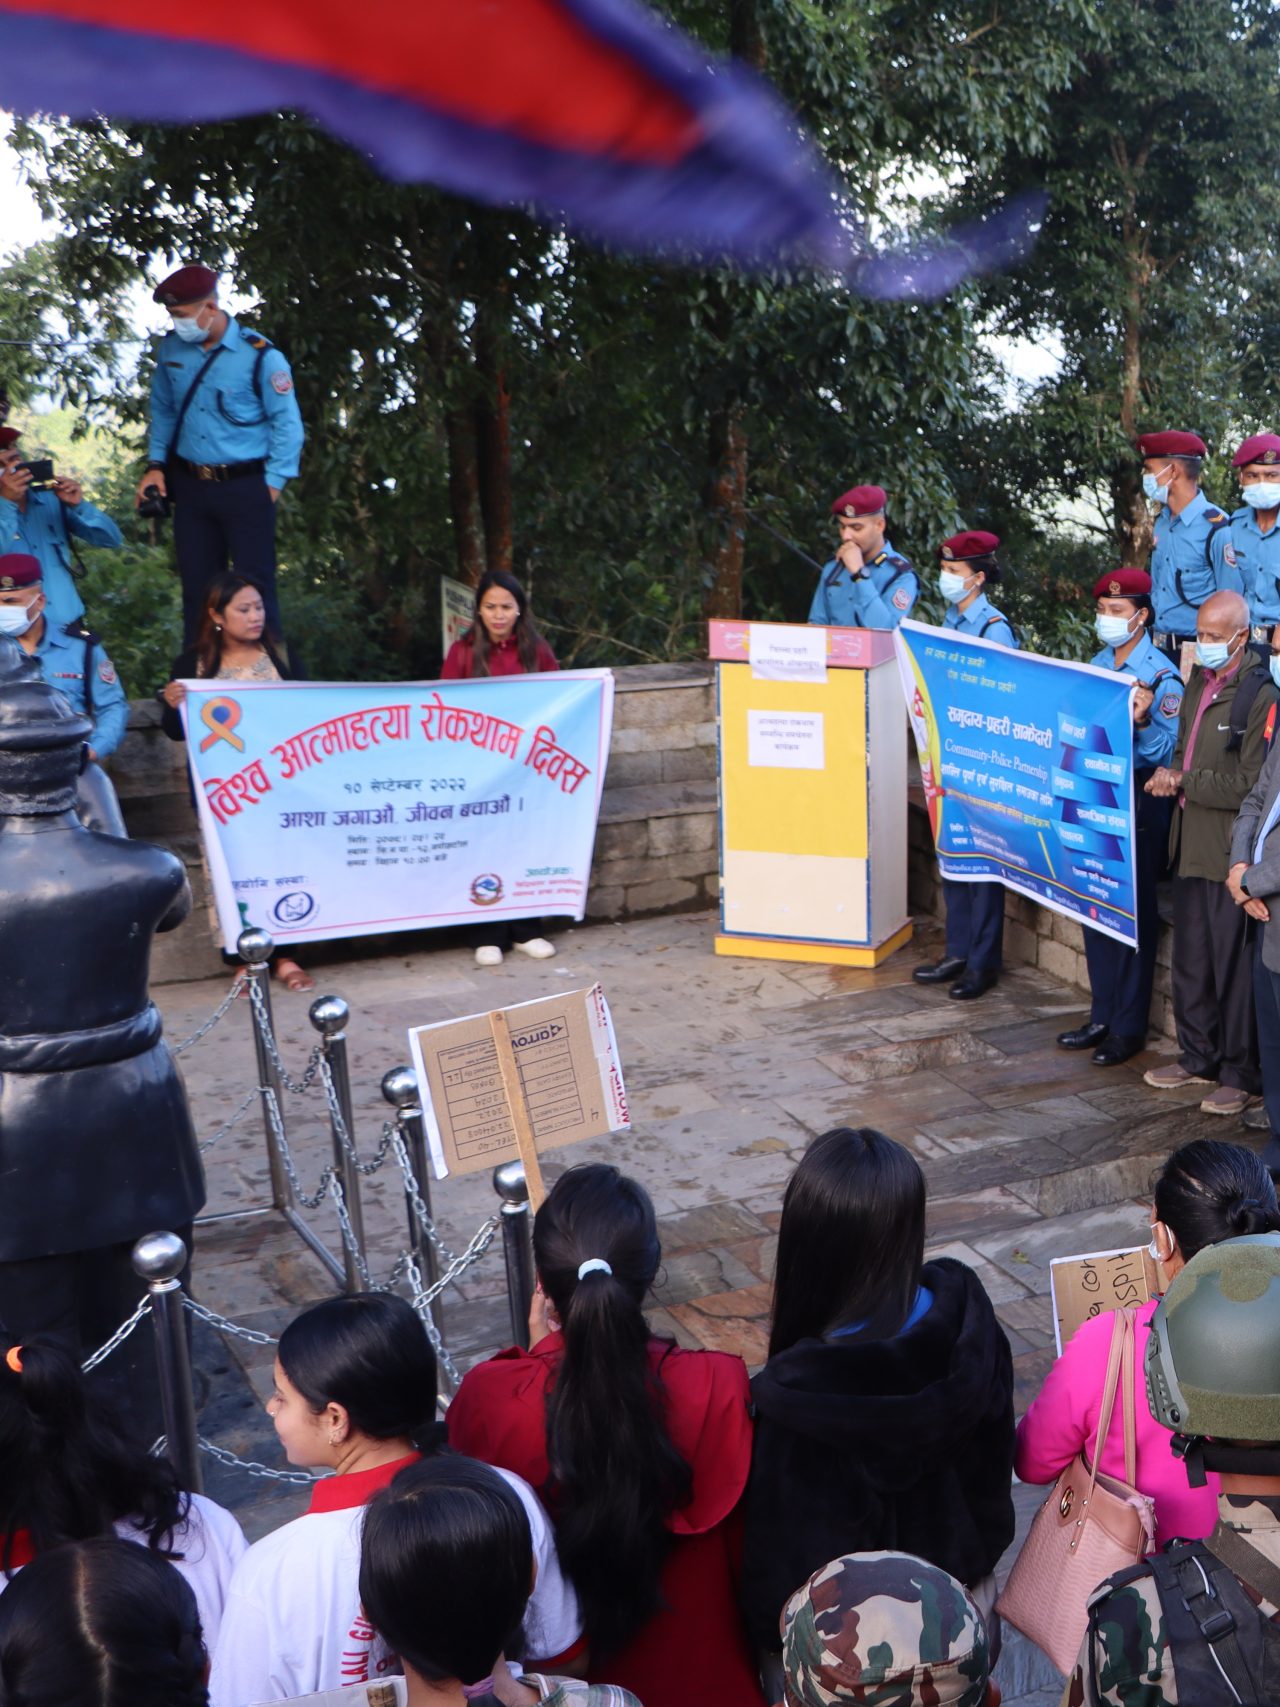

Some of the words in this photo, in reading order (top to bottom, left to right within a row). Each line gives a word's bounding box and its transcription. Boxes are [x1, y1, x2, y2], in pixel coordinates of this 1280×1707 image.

[203, 759, 272, 826] विश्व
[270, 704, 412, 779] आत्माहत्या
[420, 692, 525, 760] रोकथाम
[523, 725, 593, 794] दिवस
[343, 783, 362, 794] १०
[430, 778, 466, 792] २०२२
[280, 811, 328, 828] आशा
[405, 801, 455, 823] जीवन
